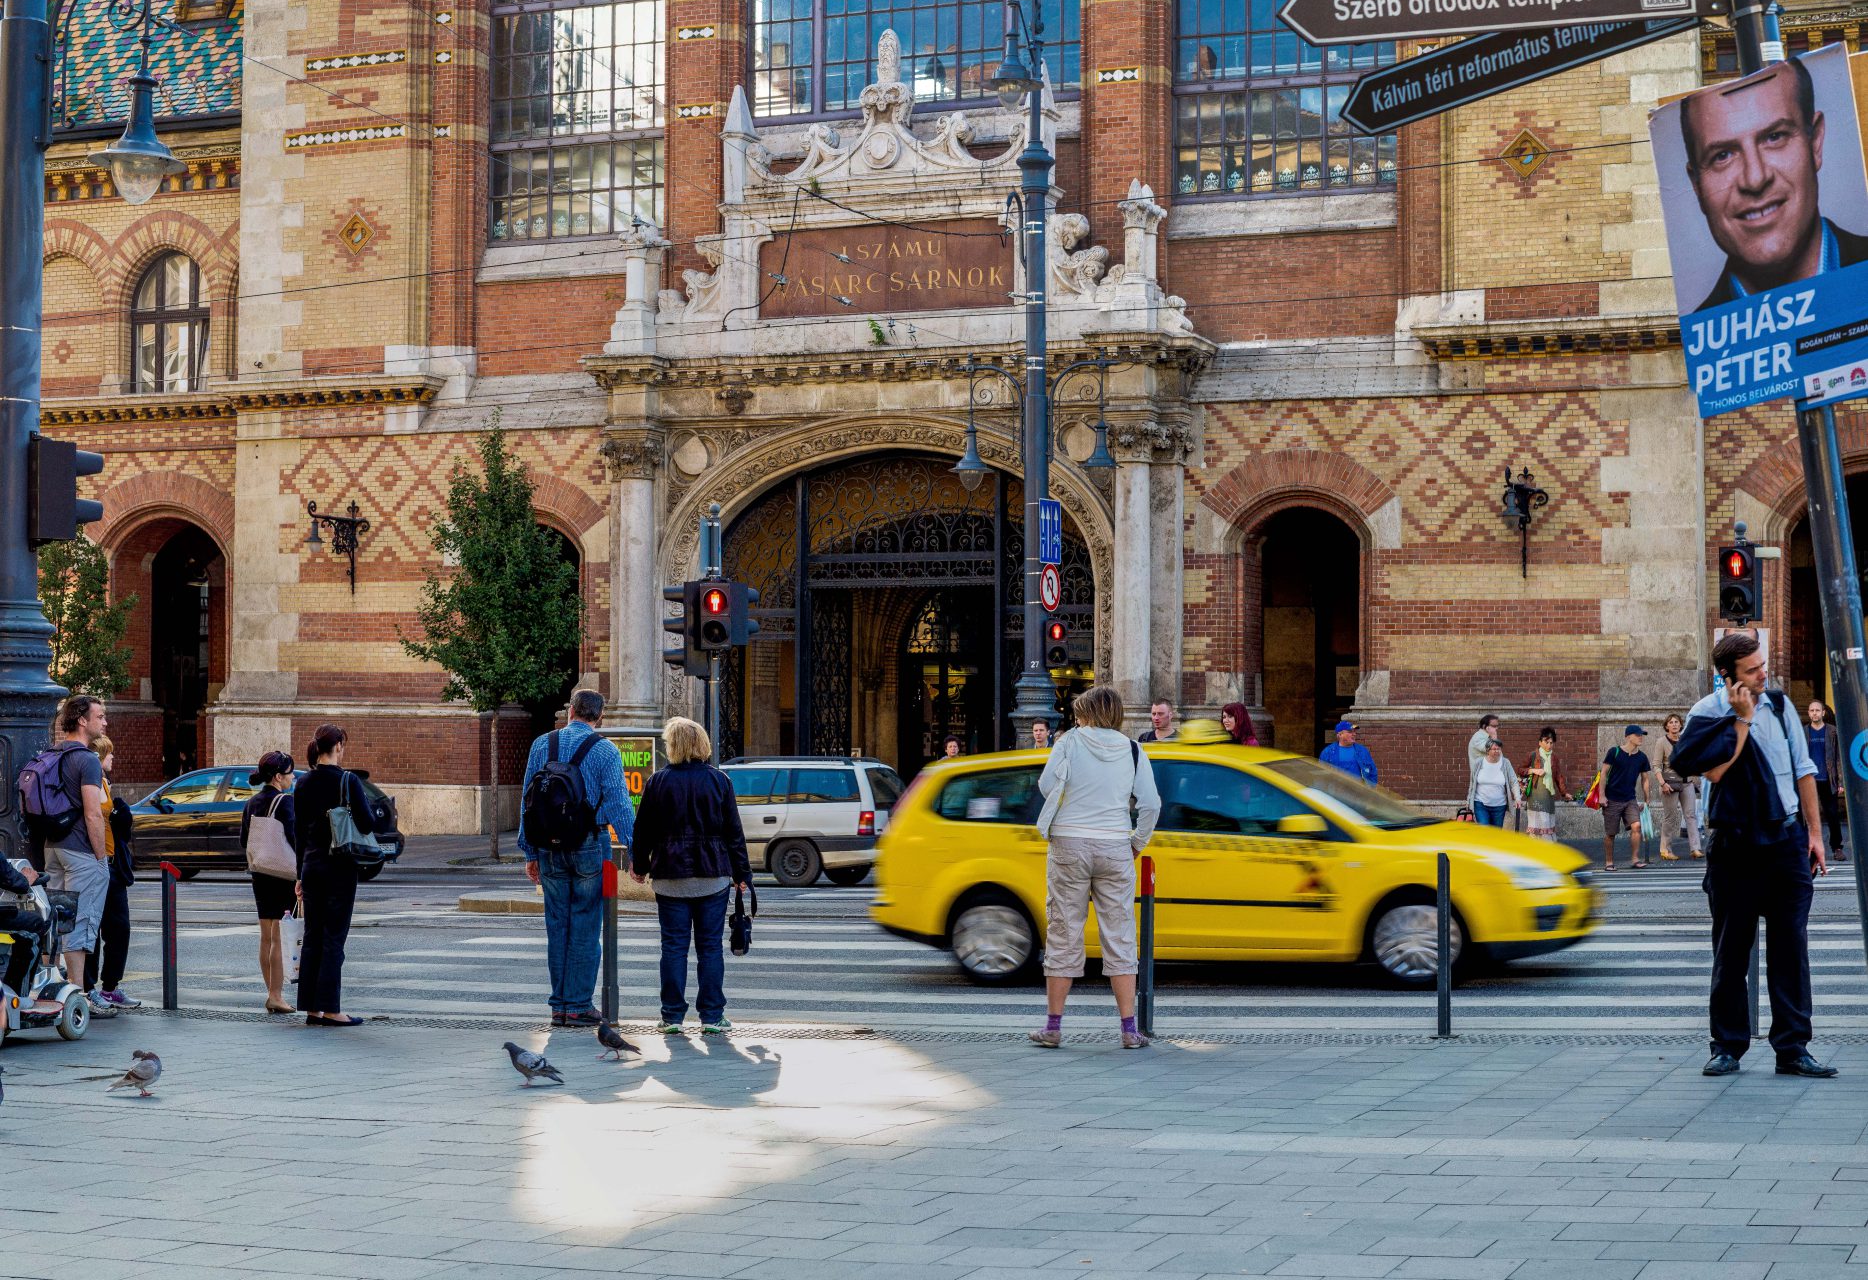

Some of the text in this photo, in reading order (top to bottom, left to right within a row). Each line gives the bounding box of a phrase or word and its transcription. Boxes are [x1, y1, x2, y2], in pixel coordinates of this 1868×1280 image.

[1371, 78, 1422, 113] Kálvin
[1425, 64, 1455, 95] téri
[1458, 34, 1551, 84] református
[1688, 288, 1816, 356] JUHÁSZ
[1800, 337, 1823, 350] ROGÁN
[1824, 331, 1841, 343] UTÁN
[1696, 342, 1793, 396] PÉTER
[1748, 378, 1800, 400] BELVÁROST
[1030, 660, 1040, 668] 27
[620, 751, 651, 767] NNEP
